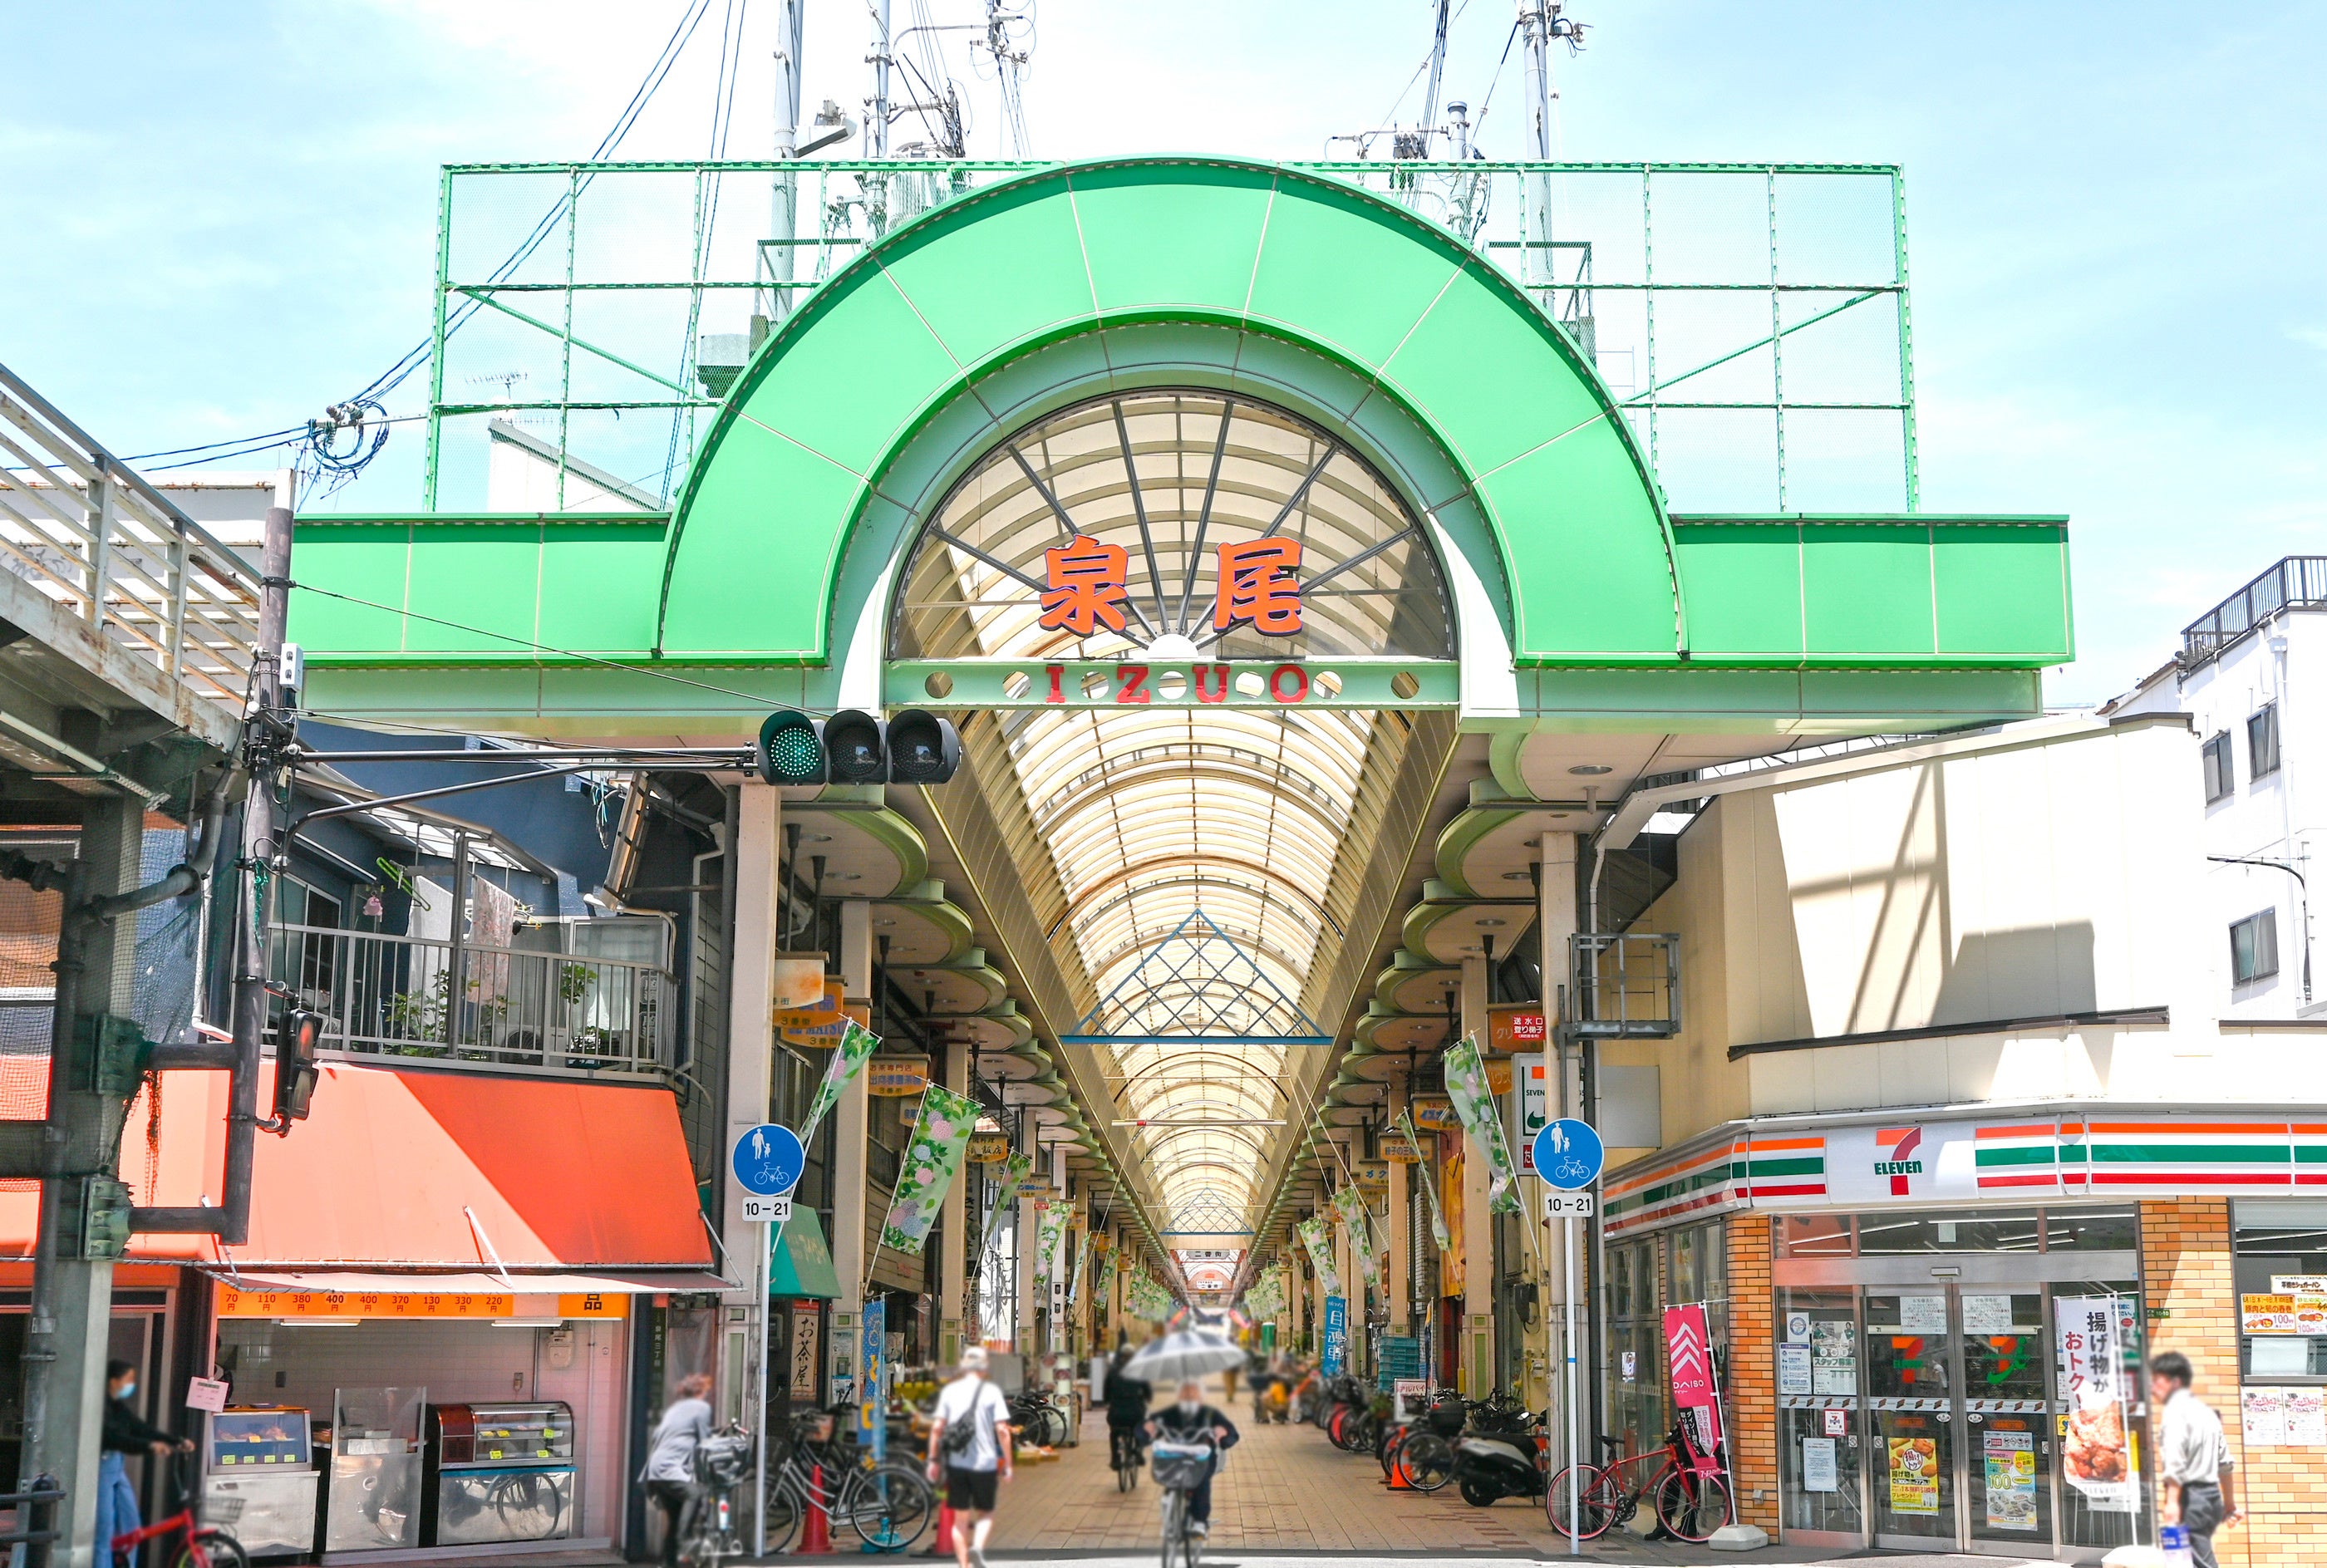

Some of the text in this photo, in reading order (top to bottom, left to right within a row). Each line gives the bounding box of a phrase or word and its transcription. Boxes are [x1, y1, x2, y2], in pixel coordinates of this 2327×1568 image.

[1039, 533, 1304, 638] 泉尾
[1045, 663, 1309, 704] IZUO
[1513, 1016, 1543, 1025] 送水口
[1513, 1025, 1543, 1035] 登り梯子
[225, 1294, 239, 1303] 70
[258, 1294, 276, 1304] 110
[293, 1295, 311, 1304] 380
[325, 1295, 344, 1305] 400
[359, 1295, 377, 1305] 400
[391, 1295, 410, 1305] 370
[423, 1296, 440, 1305] 130
[455, 1296, 472, 1305] 330
[485, 1296, 503, 1305] 220
[791, 1316, 814, 1388] お茶屋
[2086, 1311, 2110, 1394] 揚げ物が
[1673, 1379, 1705, 1389] DAISO
